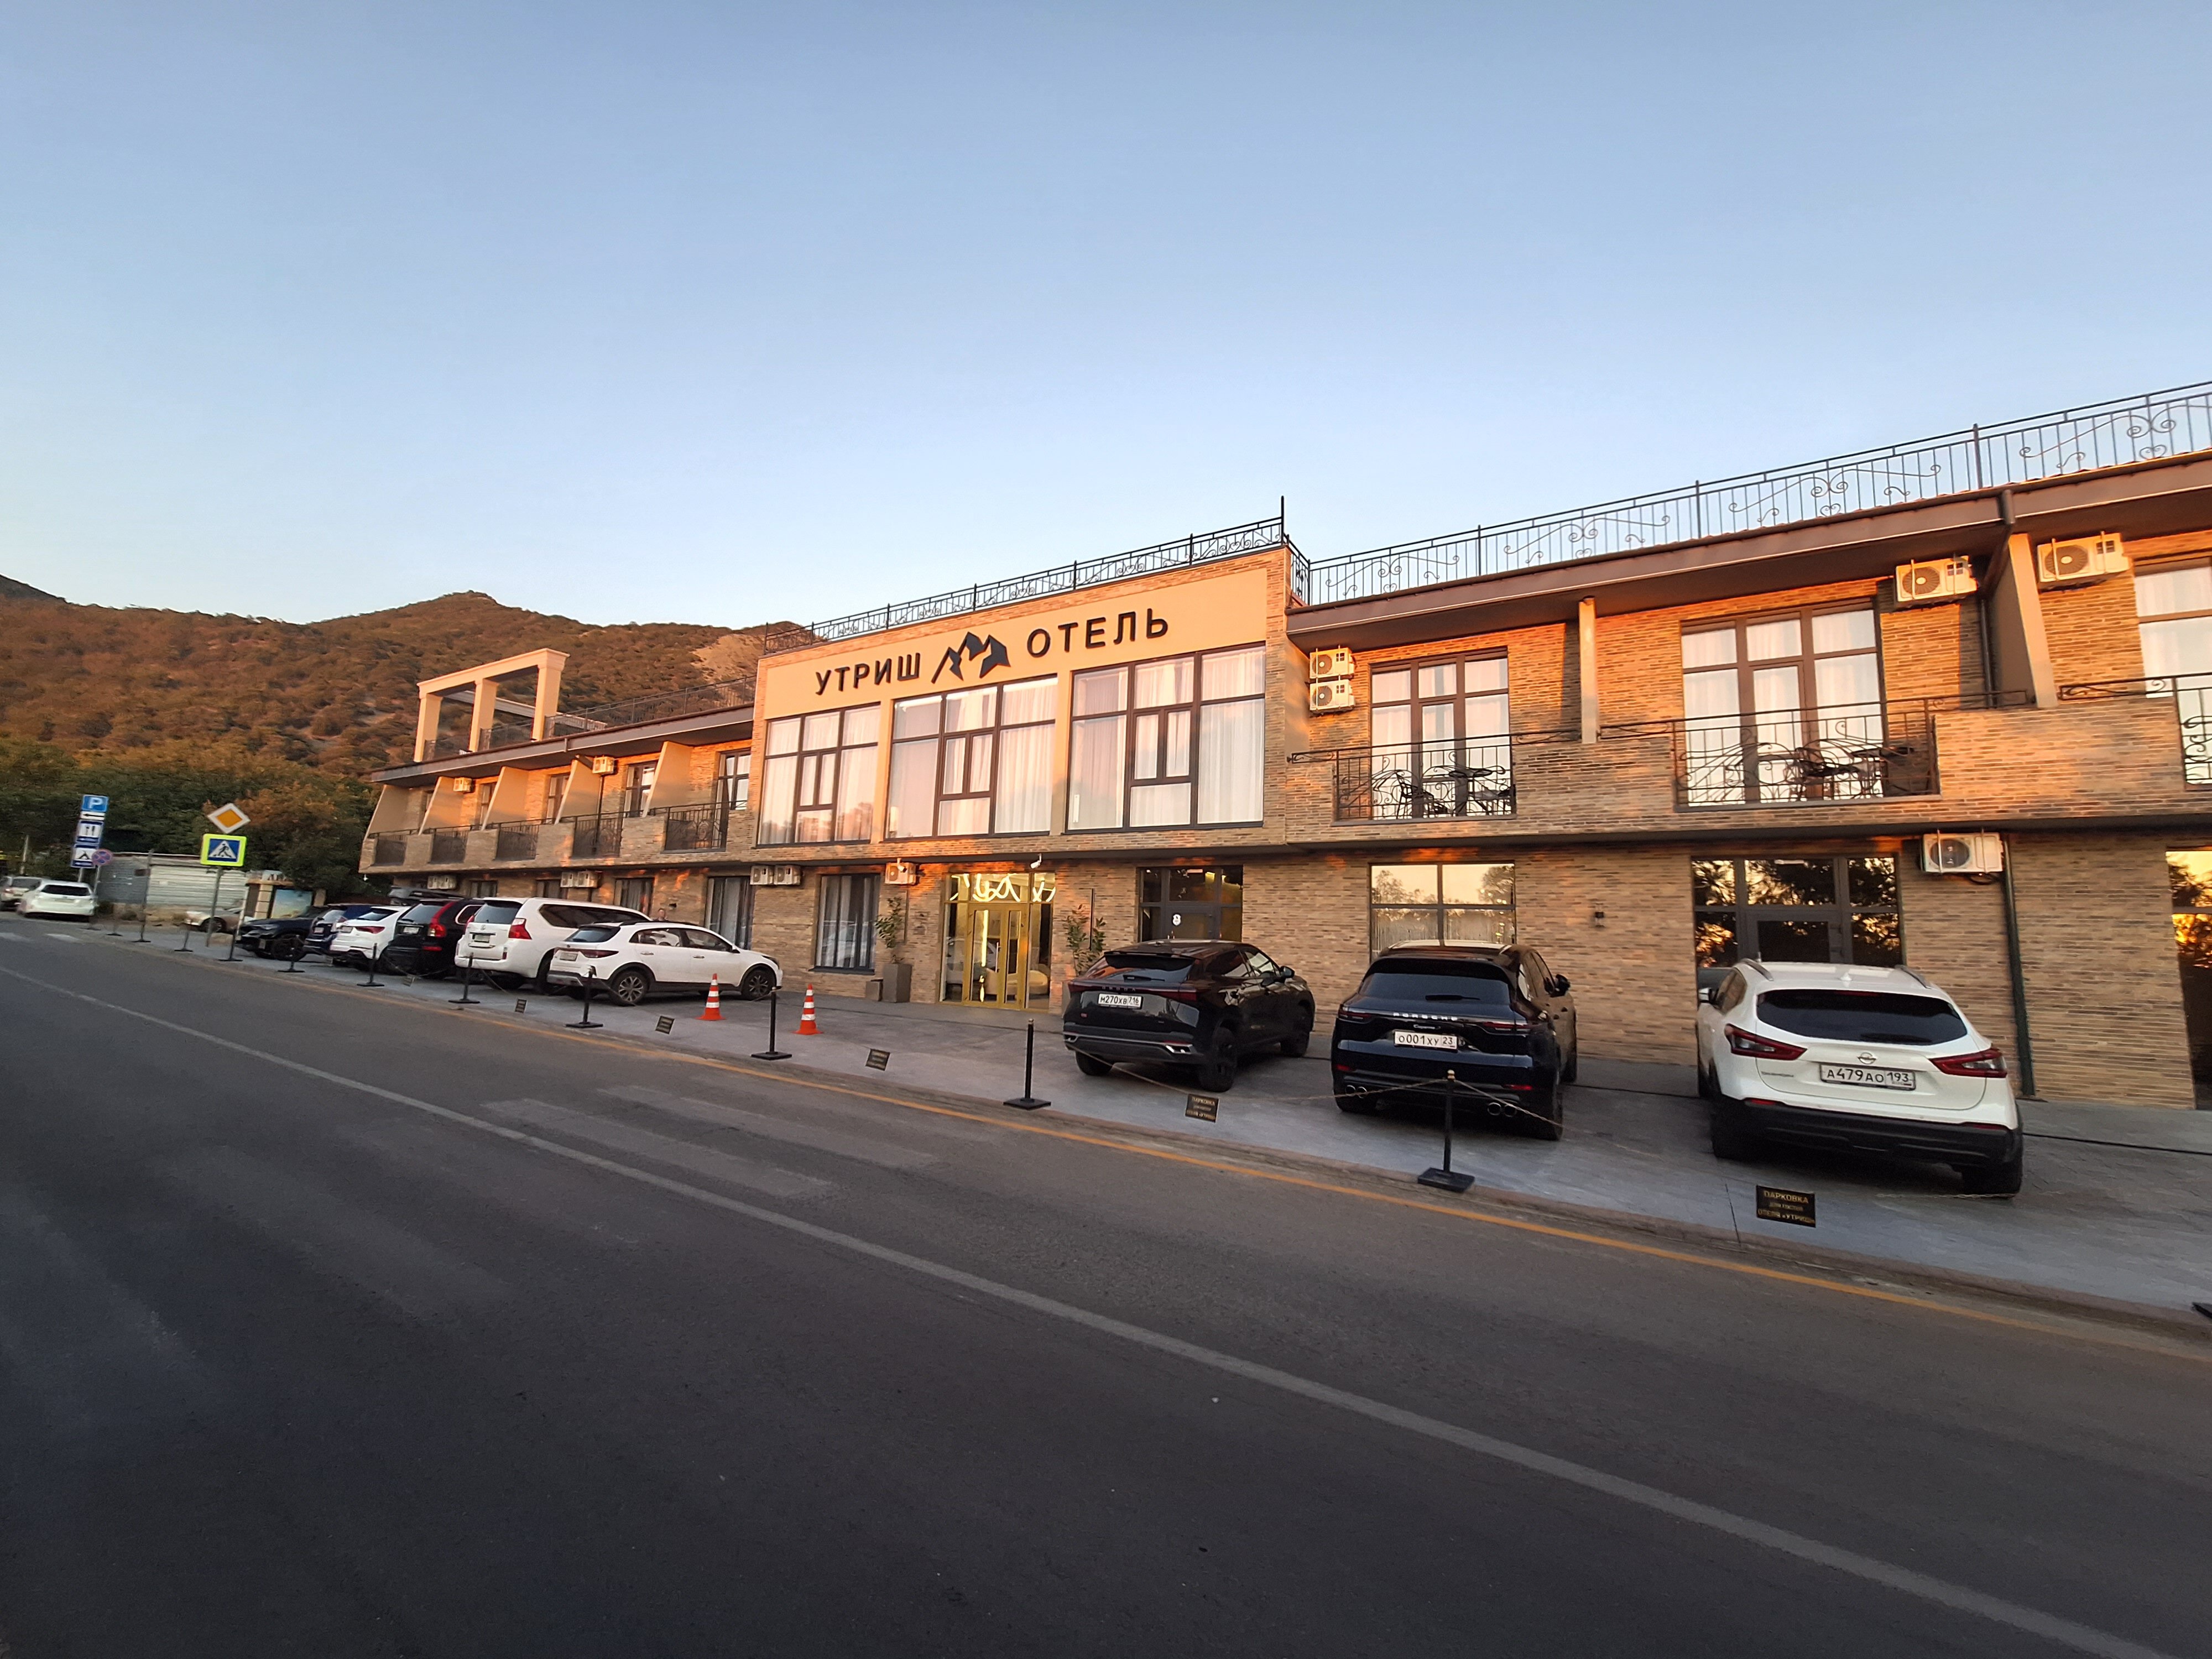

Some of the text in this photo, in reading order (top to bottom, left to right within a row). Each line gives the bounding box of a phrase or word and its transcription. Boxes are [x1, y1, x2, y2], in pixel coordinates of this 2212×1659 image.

[816, 608, 1168, 695] УТРИШ ОТЕЛЬ
[1764, 1191, 1809, 1204] ПАРКОВКА
